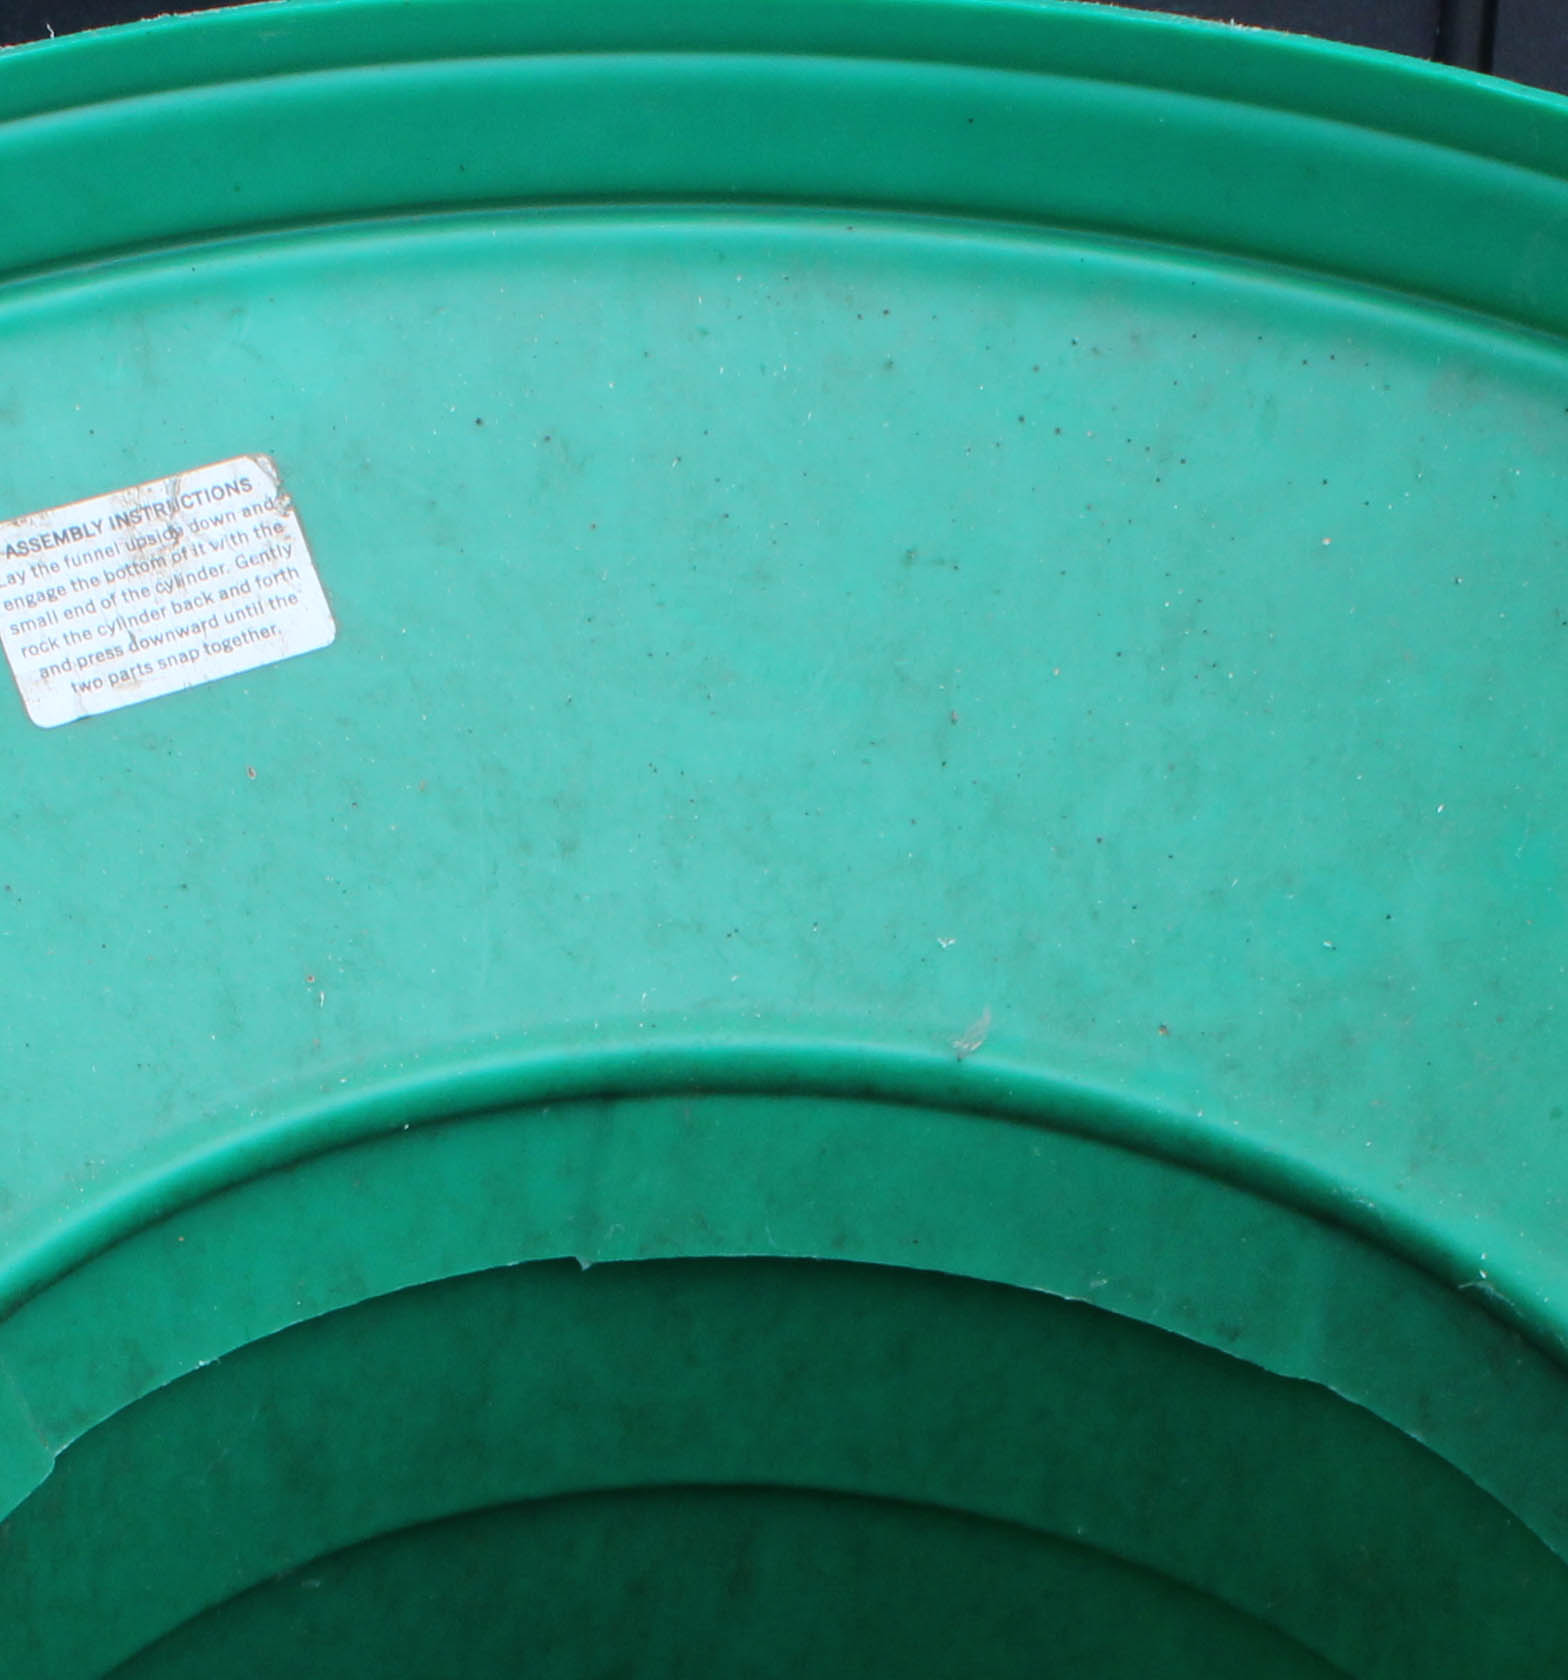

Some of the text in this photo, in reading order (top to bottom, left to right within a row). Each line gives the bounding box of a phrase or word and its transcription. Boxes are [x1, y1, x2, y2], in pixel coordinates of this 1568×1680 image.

[4, 477, 253, 560] ASSEMBLY INSTRUCTIONS
[31, 559, 60, 578] the
[64, 542, 120, 569] funnel
[187, 508, 237, 534] down
[240, 497, 275, 518] and
[3, 584, 68, 615] engage
[71, 573, 100, 593] the
[104, 554, 166, 583] bottom
[170, 547, 191, 565] of
[190, 542, 207, 558] it
[253, 520, 285, 540] the
[10, 610, 59, 637] small
[62, 600, 96, 621] end
[99, 593, 119, 610] of
[122, 584, 151, 604] the
[234, 541, 293, 573] Gently
[20, 565, 299, 659] rock the cylinder back and forth
[38, 591, 298, 680] and press downward until the
[72, 621, 282, 695] two parts snap together.
